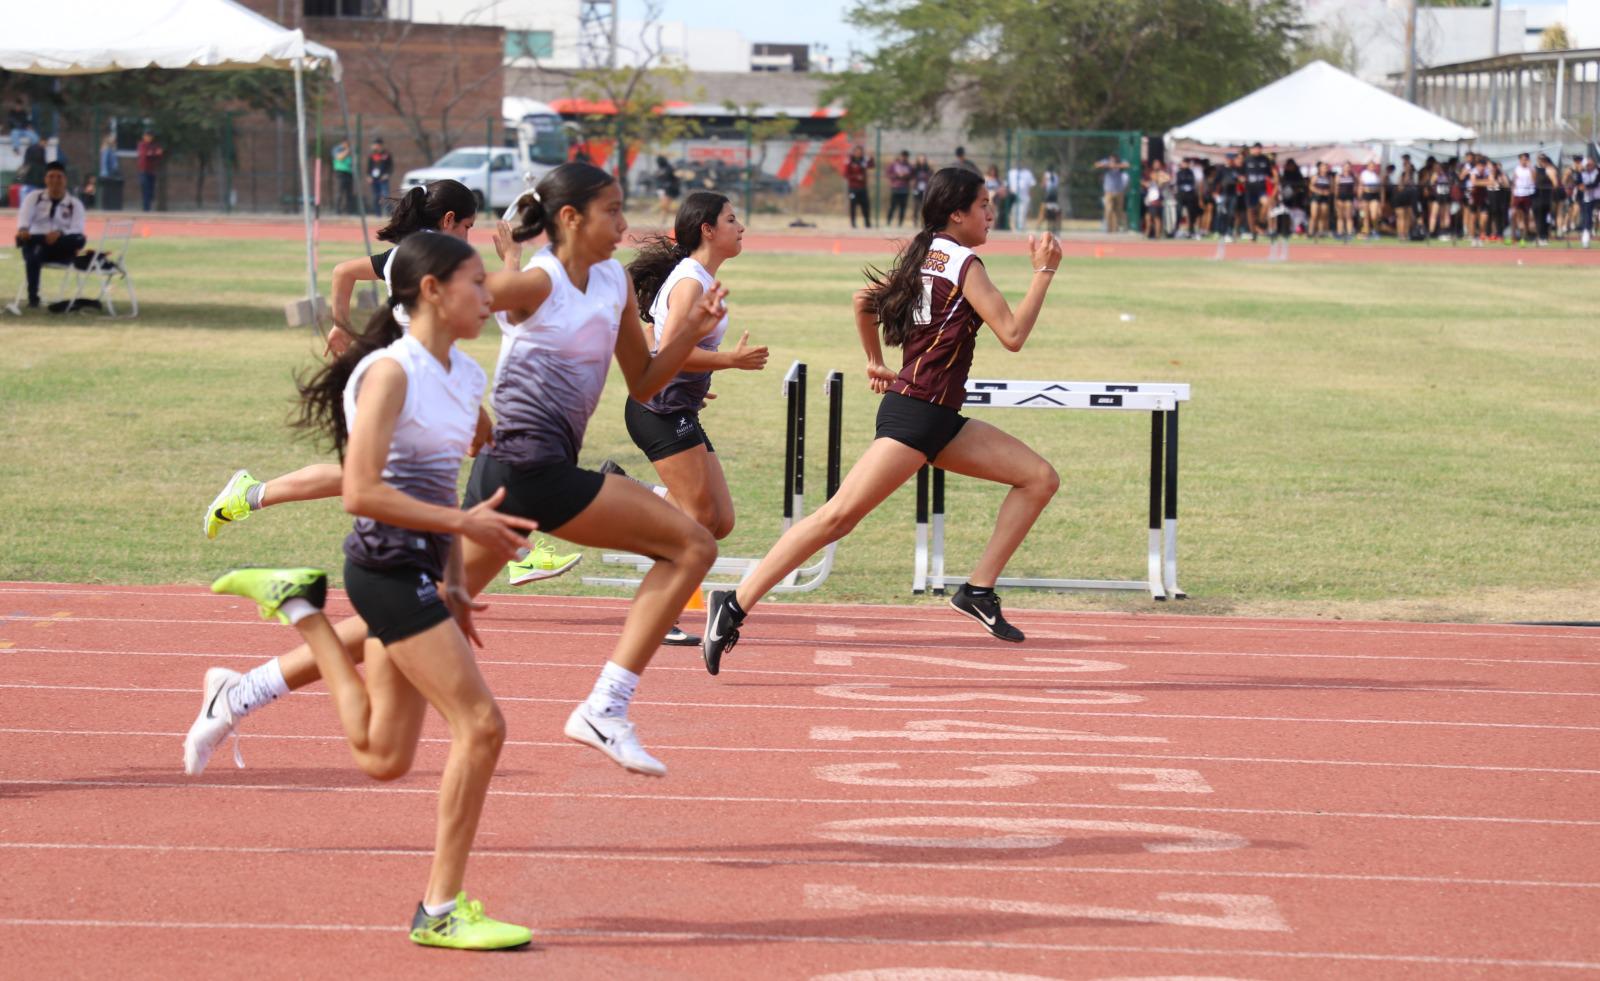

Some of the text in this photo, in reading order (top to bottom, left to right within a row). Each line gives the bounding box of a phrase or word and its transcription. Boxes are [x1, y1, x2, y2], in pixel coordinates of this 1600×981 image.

[816, 624, 1107, 640] 1
[813, 650, 1130, 672] 2
[813, 683, 1149, 704] 3
[809, 719, 1170, 744] 4
[812, 763, 1215, 794] 5
[812, 816, 1251, 854] 6
[801, 883, 1293, 933] 7
